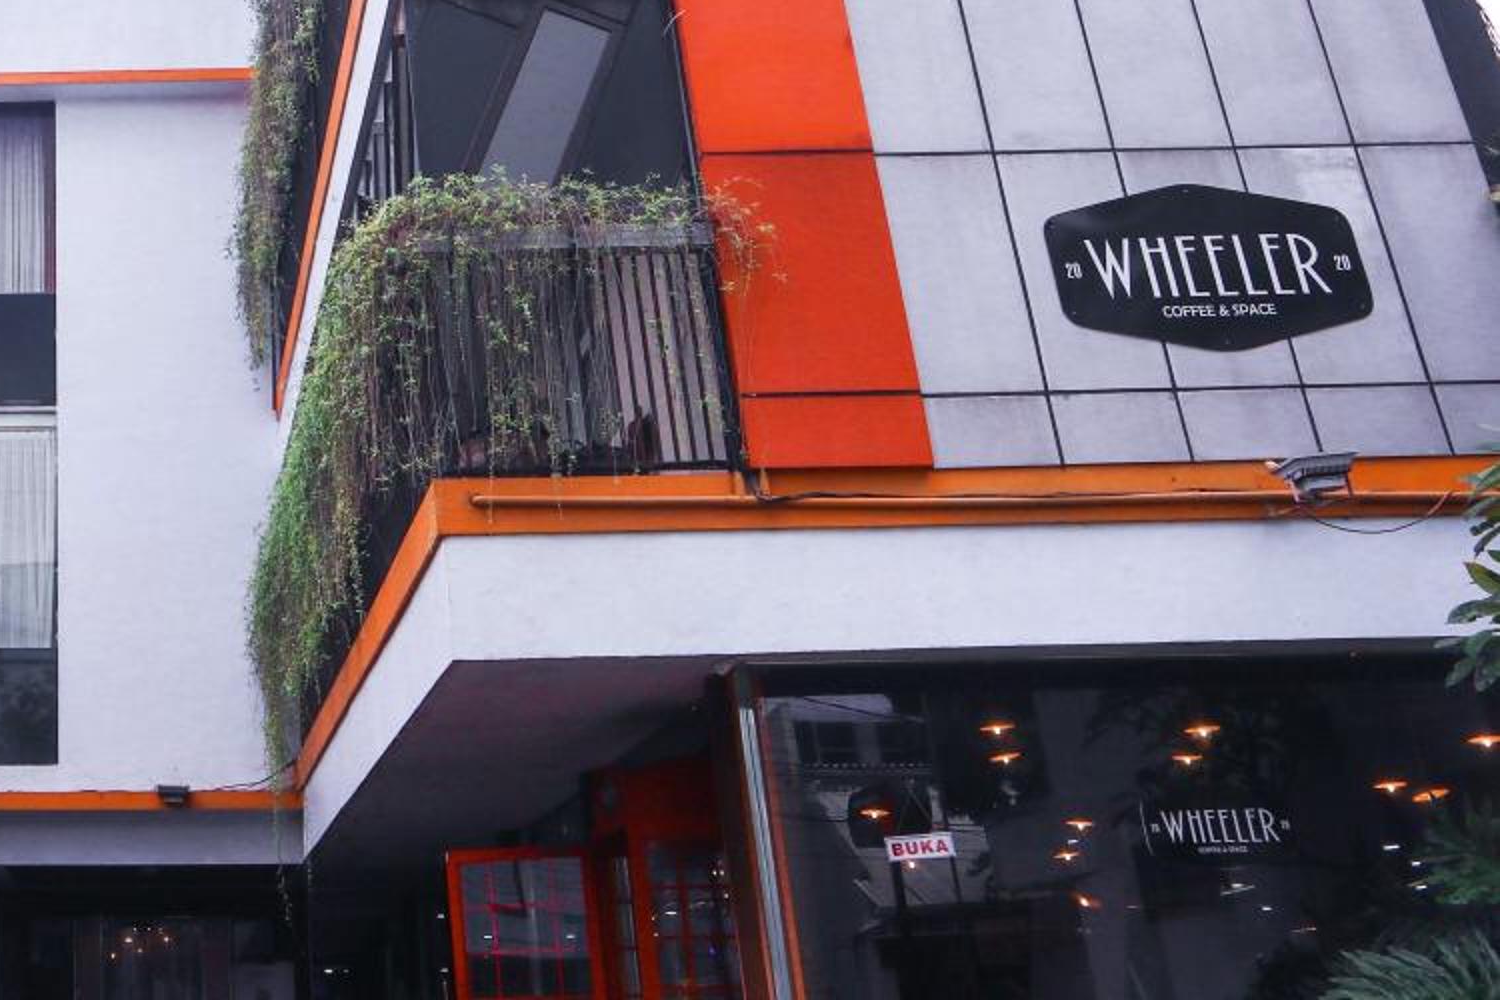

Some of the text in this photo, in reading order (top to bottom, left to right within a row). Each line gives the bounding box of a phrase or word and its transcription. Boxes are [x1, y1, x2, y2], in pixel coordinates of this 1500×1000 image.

[1084, 233, 1333, 299] WHEELER
[1163, 303, 1278, 317] COFFEE & SPACE
[1160, 808, 1281, 843] WHEELER
[891, 839, 950, 857] BUKA
